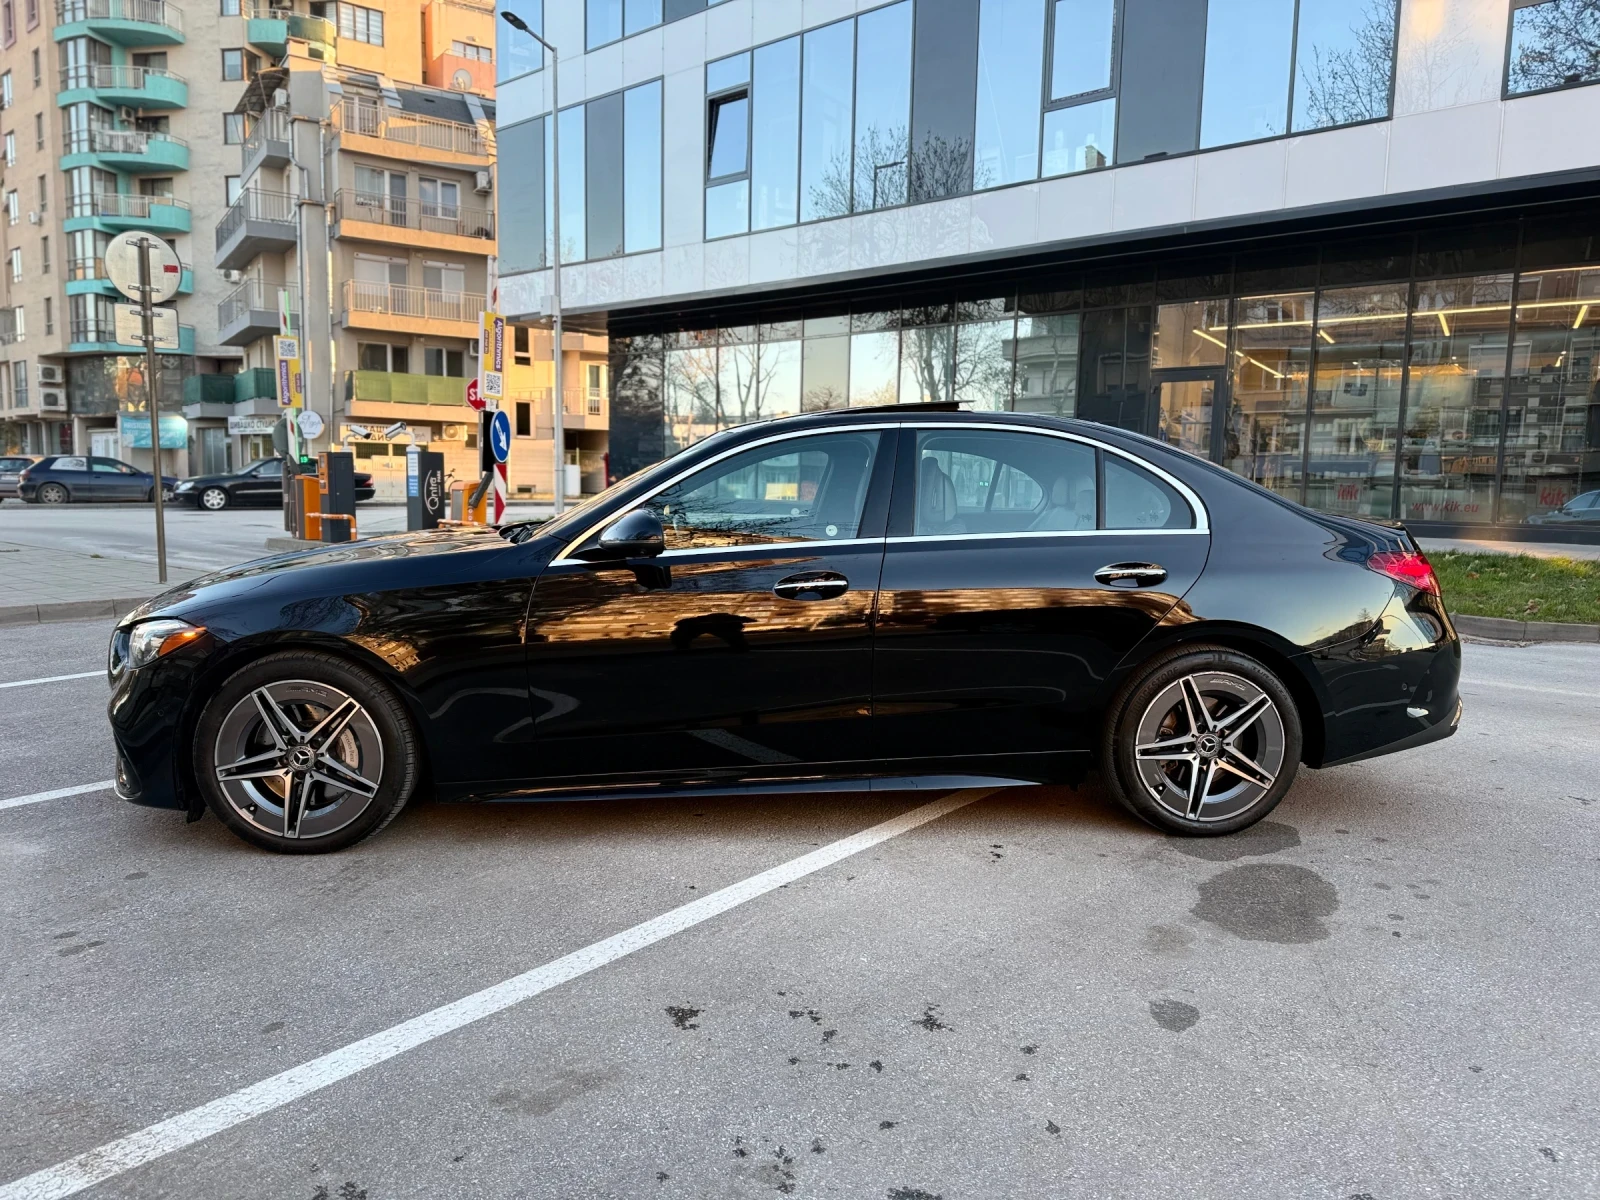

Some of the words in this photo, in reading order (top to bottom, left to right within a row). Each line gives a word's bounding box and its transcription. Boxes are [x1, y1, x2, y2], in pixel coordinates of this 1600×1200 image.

[495, 320, 503, 369] Algorithmics
[281, 362, 289, 403] Algorithmics
[1540, 486, 1567, 506] kik
